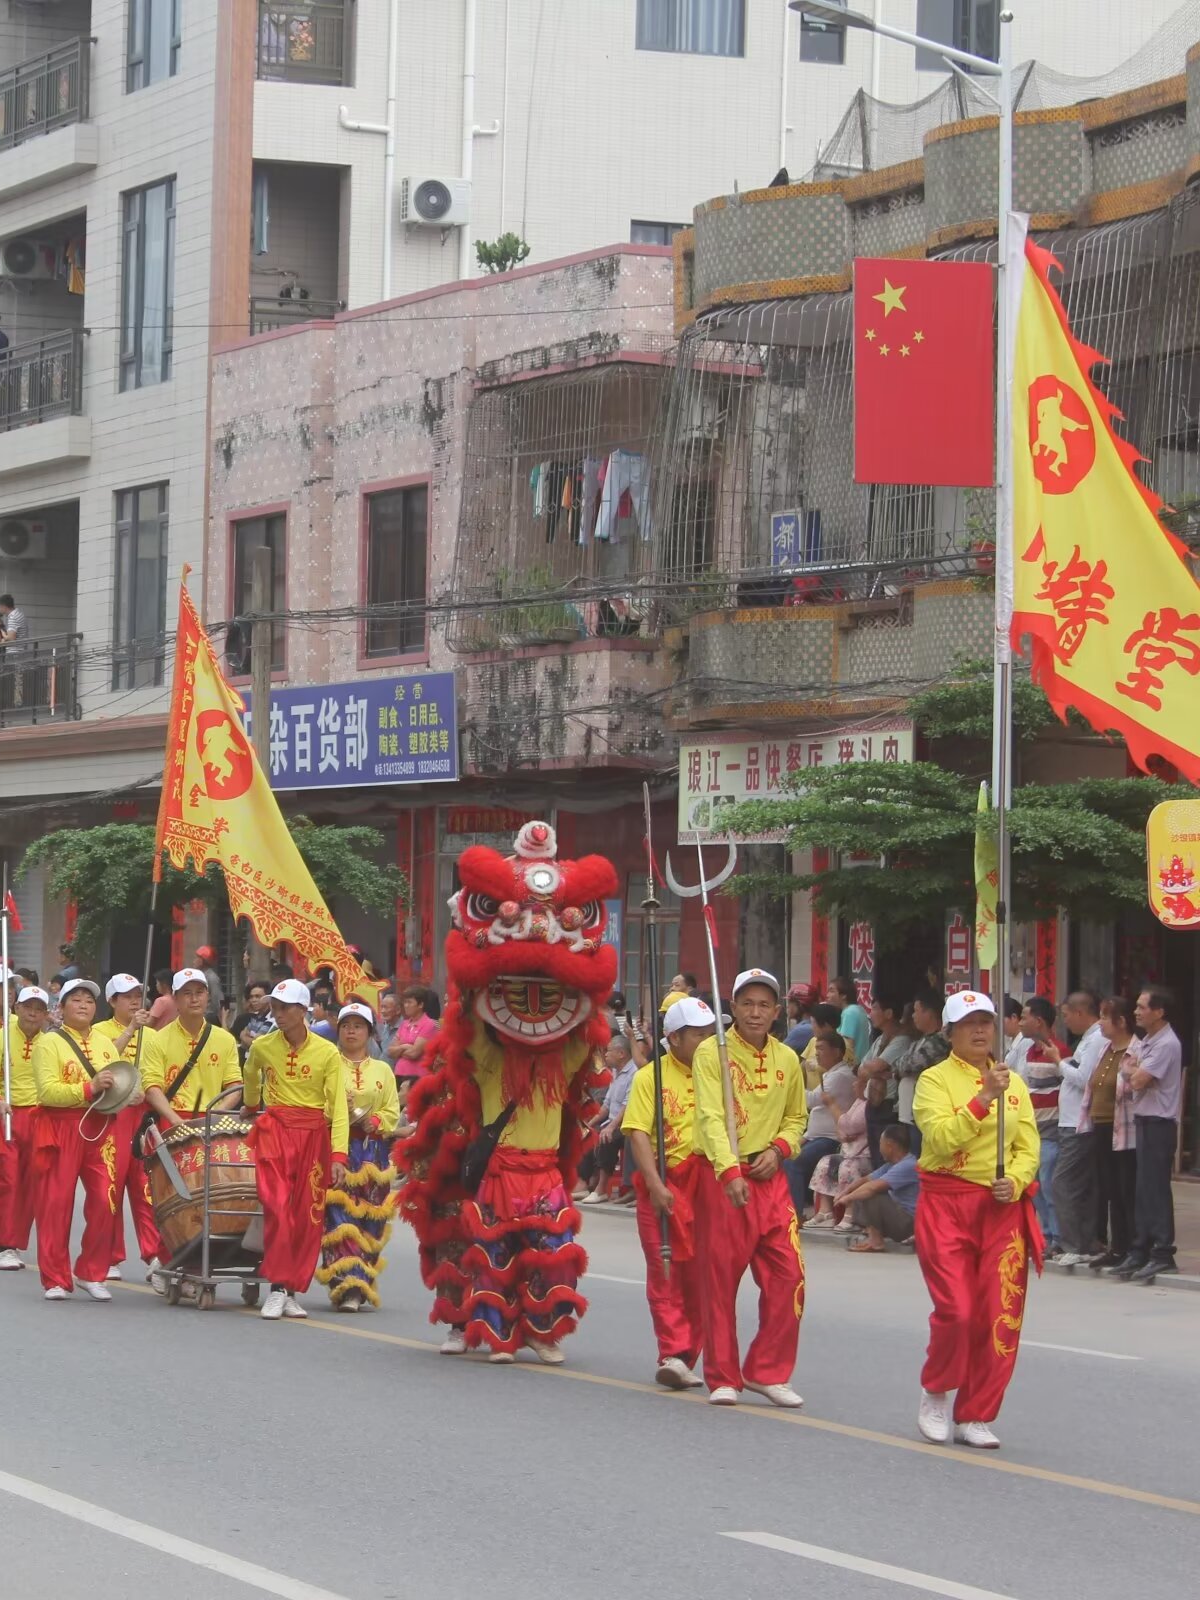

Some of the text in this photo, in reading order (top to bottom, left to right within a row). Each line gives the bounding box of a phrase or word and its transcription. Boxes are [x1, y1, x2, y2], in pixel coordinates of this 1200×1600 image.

[1021, 523, 1200, 712] 精堂
[395, 683, 422, 701] 经营
[192, 1141, 252, 1167] 金精堂
